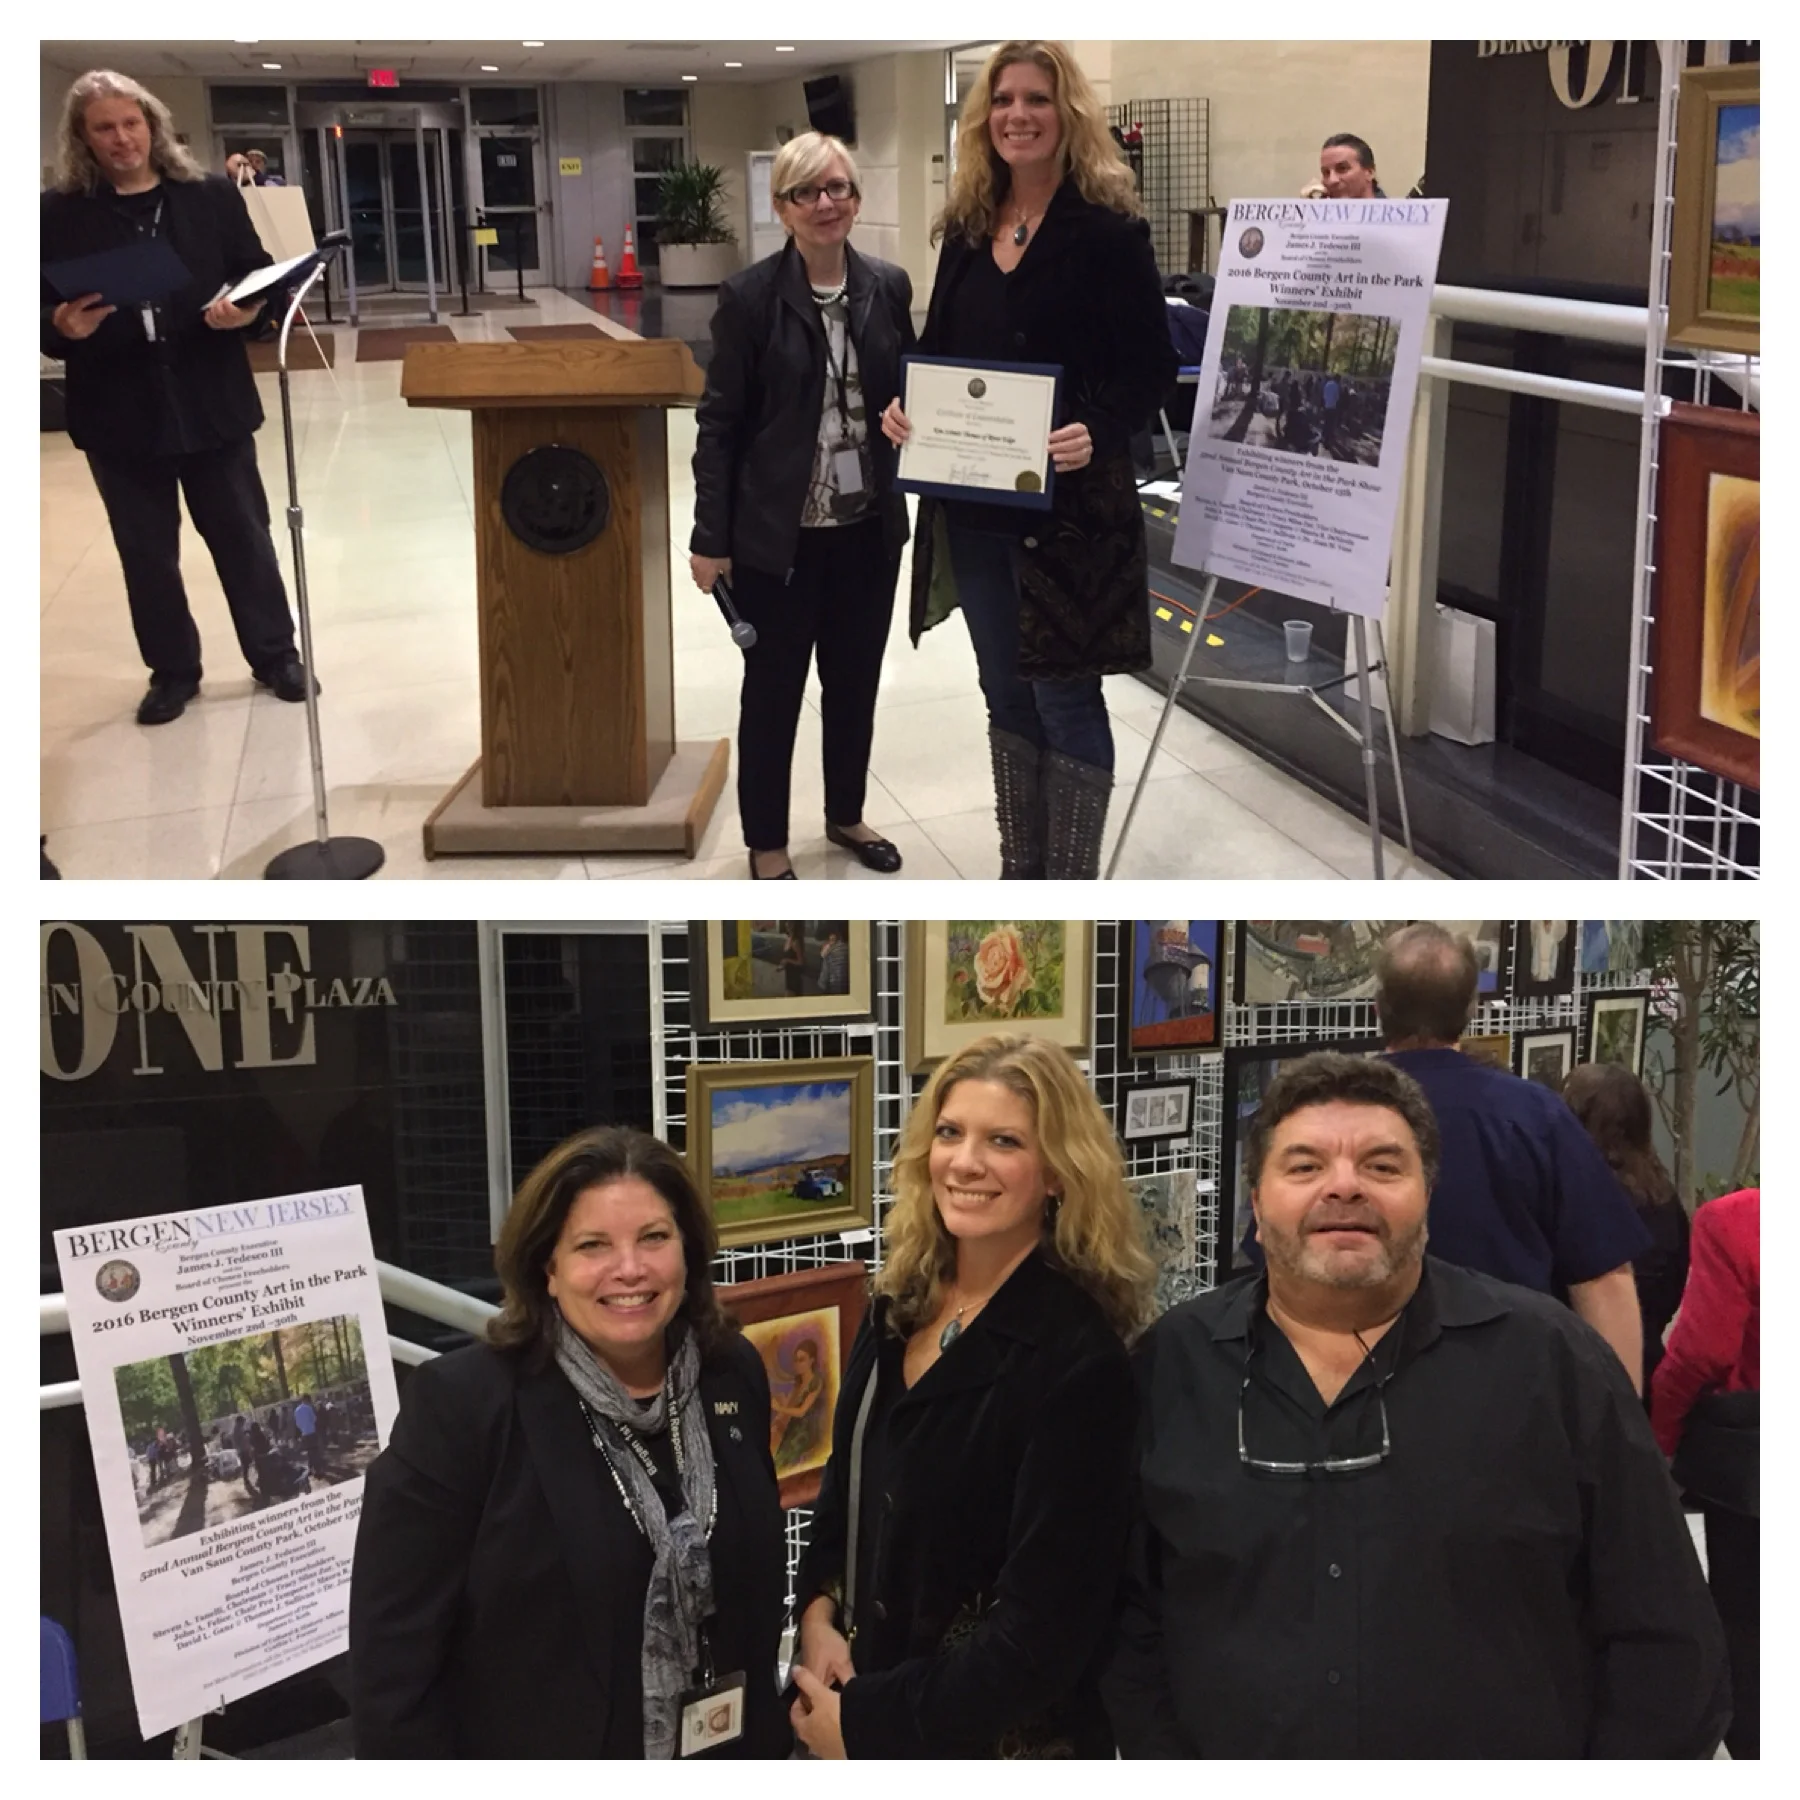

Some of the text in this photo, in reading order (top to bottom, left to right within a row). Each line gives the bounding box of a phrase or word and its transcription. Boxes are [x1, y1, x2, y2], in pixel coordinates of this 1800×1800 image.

[1234, 204, 1435, 224] BERGEN NEW JERSEY
[1227, 268, 1423, 287] 2016 Bergen County Art in the Park
[1270, 283, 1363, 300] Winners' Exhibit
[40, 921, 317, 1082] ONE
[270, 970, 399, 1009] PLAZA
[68, 1192, 353, 1258] BERGEN NEW JERSEY
[176, 1263, 212, 1275] James
[214, 1259, 224, 1267] J.
[227, 1252, 268, 1265] Tedesco
[270, 1247, 283, 1256] III
[179, 1240, 278, 1262] Bergen County Executive
[92, 1263, 368, 1334] 2016 Bergen County Art in the Park
[172, 1295, 306, 1335] Winners' Exhibit
[186, 1325, 243, 1346] November
[245, 1319, 266, 1334] 2nd
[199, 1491, 343, 1546] Exhibiting winners from the
[139, 1561, 169, 1582] 52nd
[171, 1548, 213, 1570] Annual
[215, 1533, 255, 1556] Bergen
[256, 1521, 294, 1541] County
[296, 1513, 312, 1526] Art
[313, 1508, 324, 1519] in
[326, 1503, 341, 1516] the
[181, 1564, 204, 1579] Van
[206, 1553, 234, 1570] Saun
[235, 1540, 274, 1560] County
[304, 1513, 344, 1534] October
